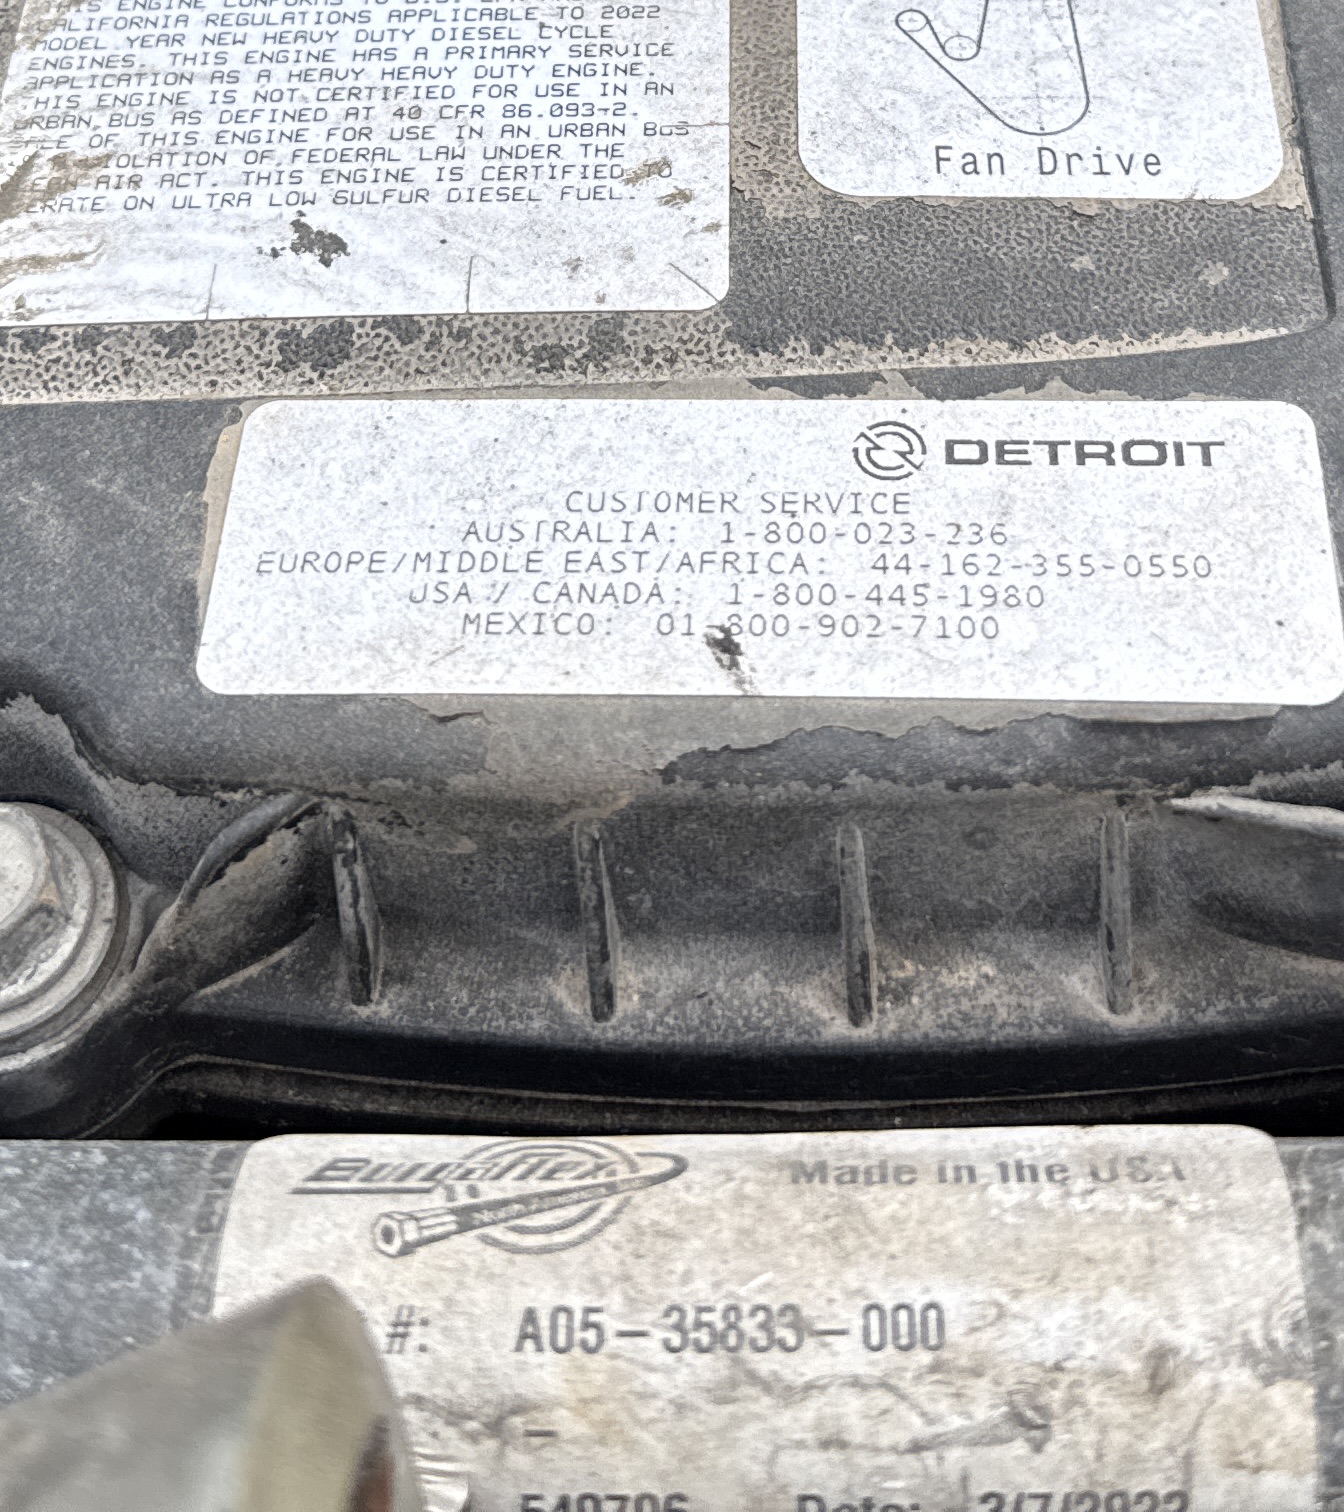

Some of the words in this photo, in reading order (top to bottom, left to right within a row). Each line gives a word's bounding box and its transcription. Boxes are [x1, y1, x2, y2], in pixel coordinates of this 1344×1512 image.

[206, 10, 371, 27] REGULATIONS
[387, 6, 538, 23] APPLICABLE
[556, 5, 584, 19] TO
[600, 4, 661, 19] 2022
[125, 33, 185, 48] YEAR
[201, 31, 246, 46] NEW
[262, 29, 339, 44] HEAVY
[354, 28, 416, 42] DUTY
[431, 26, 522, 41] DIESEL
[538, 24, 613, 39] CYCLE
[27, 54, 146, 70] ENGINES.
[168, 51, 228, 66] THIS
[244, 48, 337, 64] ENGINE
[349, 47, 398, 61] HAS
[413, 46, 428, 60] A
[444, 44, 551, 59] PRIMARY
[568, 42, 675, 57] SERVICE
[26, 71, 193, 88] APPLICATION
[209, 70, 240, 84] AS
[256, 69, 271, 82] A
[287, 67, 365, 82] HEAVY
[381, 65, 458, 80] HEAVY
[474, 64, 535, 78] DUTY
[551, 61, 655, 77] ENGINE.
[95, 91, 191, 107] ENGINE
[208, 90, 237, 104] IS
[253, 88, 299, 102] NOT
[315, 85, 455, 101] CERTIFIED
[472, 83, 518, 98] FOR
[534, 83, 580, 97] USE
[599, 82, 627, 96] IN
[643, 81, 674, 95] AN
[108, 112, 155, 127] BUS
[170, 110, 202, 124] AS
[218, 107, 327, 123] DEFINED
[344, 106, 375, 120] AT
[392, 105, 421, 119] 40
[438, 104, 485, 118] CFR
[501, 101, 638, 118] 86.093-2.
[88, 133, 116, 147] OF
[138, 131, 198, 146] THIS
[214, 128, 309, 144] ENGINE
[325, 127, 373, 141] FOR
[389, 126, 436, 140] USE
[455, 125, 483, 139] IN
[500, 123, 531, 138] AN
[548, 122, 626, 137] URBAN
[243, 149, 276, 163] OF
[291, 147, 401, 162] FEDERAL
[418, 146, 465, 160] LAW
[482, 144, 561, 159] UNDER
[579, 143, 624, 157] THE
[934, 144, 1006, 177] Fan
[1037, 145, 1163, 177] Drive
[95, 174, 142, 189] AIR
[159, 172, 218, 187] ACT.
[242, 170, 303, 185] THIS
[320, 168, 415, 183] ENGINE
[435, 167, 463, 181] IS
[480, 164, 624, 180] CERTIFIED
[123, 196, 155, 210] ON
[171, 193, 251, 208] ULTRA
[268, 192, 315, 206] LOW
[332, 189, 429, 204] SULFUR
[446, 187, 542, 202] DIESEL
[560, 185, 636, 200] FUEL.
[944, 439, 1225, 466] DETROIT
[565, 490, 740, 514] CUSTOMER
[760, 491, 912, 515] SERVICE
[461, 520, 677, 544] AUSTRALIA:
[720, 521, 1009, 546] 1-800-023-236
[256, 550, 544, 574] EUROPE/MIDDLE
[563, 550, 827, 575] EAST/AFRICA:
[870, 554, 1212, 578] 44-162-355-0550
[409, 582, 472, 605] USA
[532, 582, 682, 606] CANADA:
[729, 583, 1045, 608] 1-800-445-1980
[461, 612, 614, 637] MEXICO:
[789, 1158, 918, 1185] Made
[937, 1159, 977, 1184] in
[997, 1159, 1069, 1185] the
[514, 1302, 946, 1354] A05-35833-000
